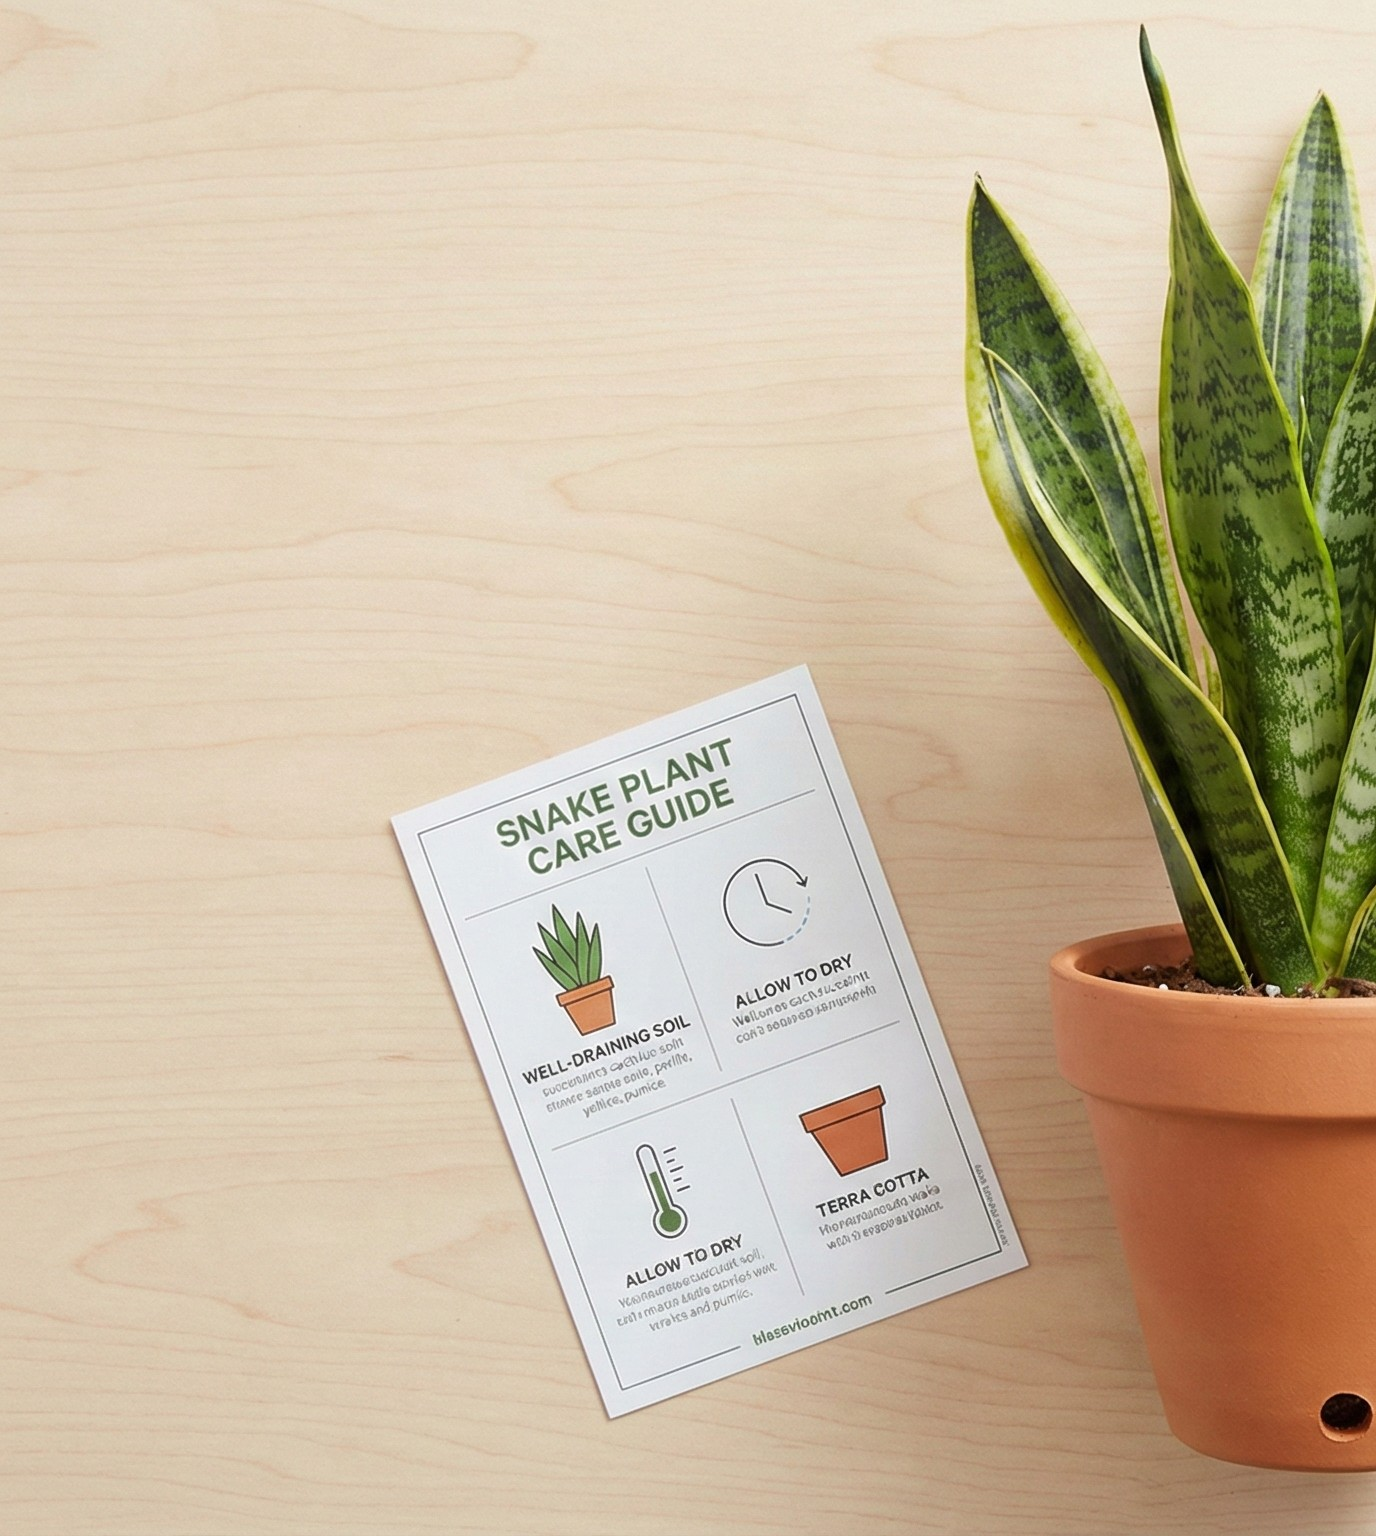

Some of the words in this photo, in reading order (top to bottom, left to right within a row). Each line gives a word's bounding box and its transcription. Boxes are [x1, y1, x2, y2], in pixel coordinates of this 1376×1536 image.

[497, 783, 615, 847] SNAKE
[618, 737, 732, 803] PLANT
[528, 820, 622, 874] CARE
[627, 778, 735, 837] GUIDE
[737, 976, 791, 1009] ALLOW
[793, 968, 817, 985] TO
[819, 953, 851, 976] DRY
[522, 1028, 651, 1084] WELL-DRAINING
[653, 1015, 691, 1037] SOIL
[815, 1189, 872, 1217] TERRA
[873, 1167, 930, 1197] COTTA
[627, 1256, 681, 1288] ALLOW
[683, 1248, 708, 1265] TO
[710, 1233, 742, 1257] DRY
